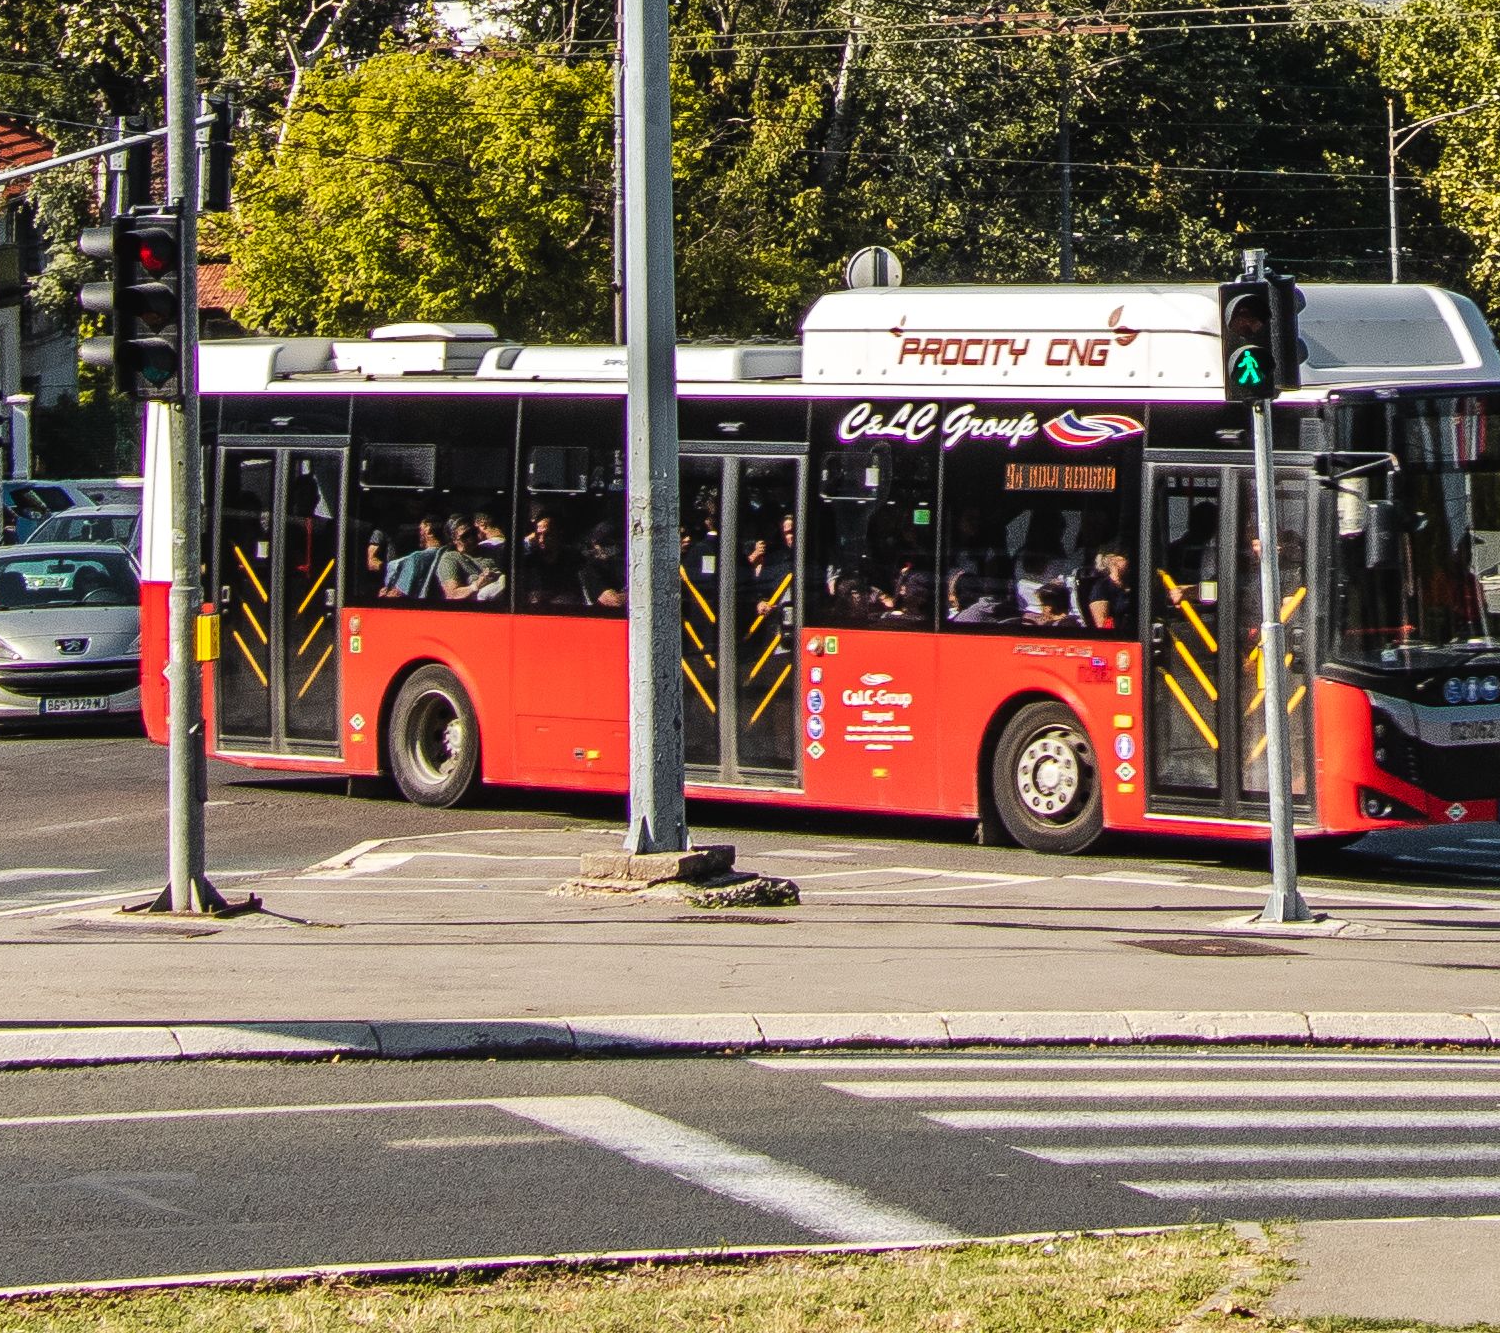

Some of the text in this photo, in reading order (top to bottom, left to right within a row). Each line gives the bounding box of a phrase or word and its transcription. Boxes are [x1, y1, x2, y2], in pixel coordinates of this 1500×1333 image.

[897, 339, 1111, 367] PROCITY CNG
[839, 402, 1039, 449] C&LC Group
